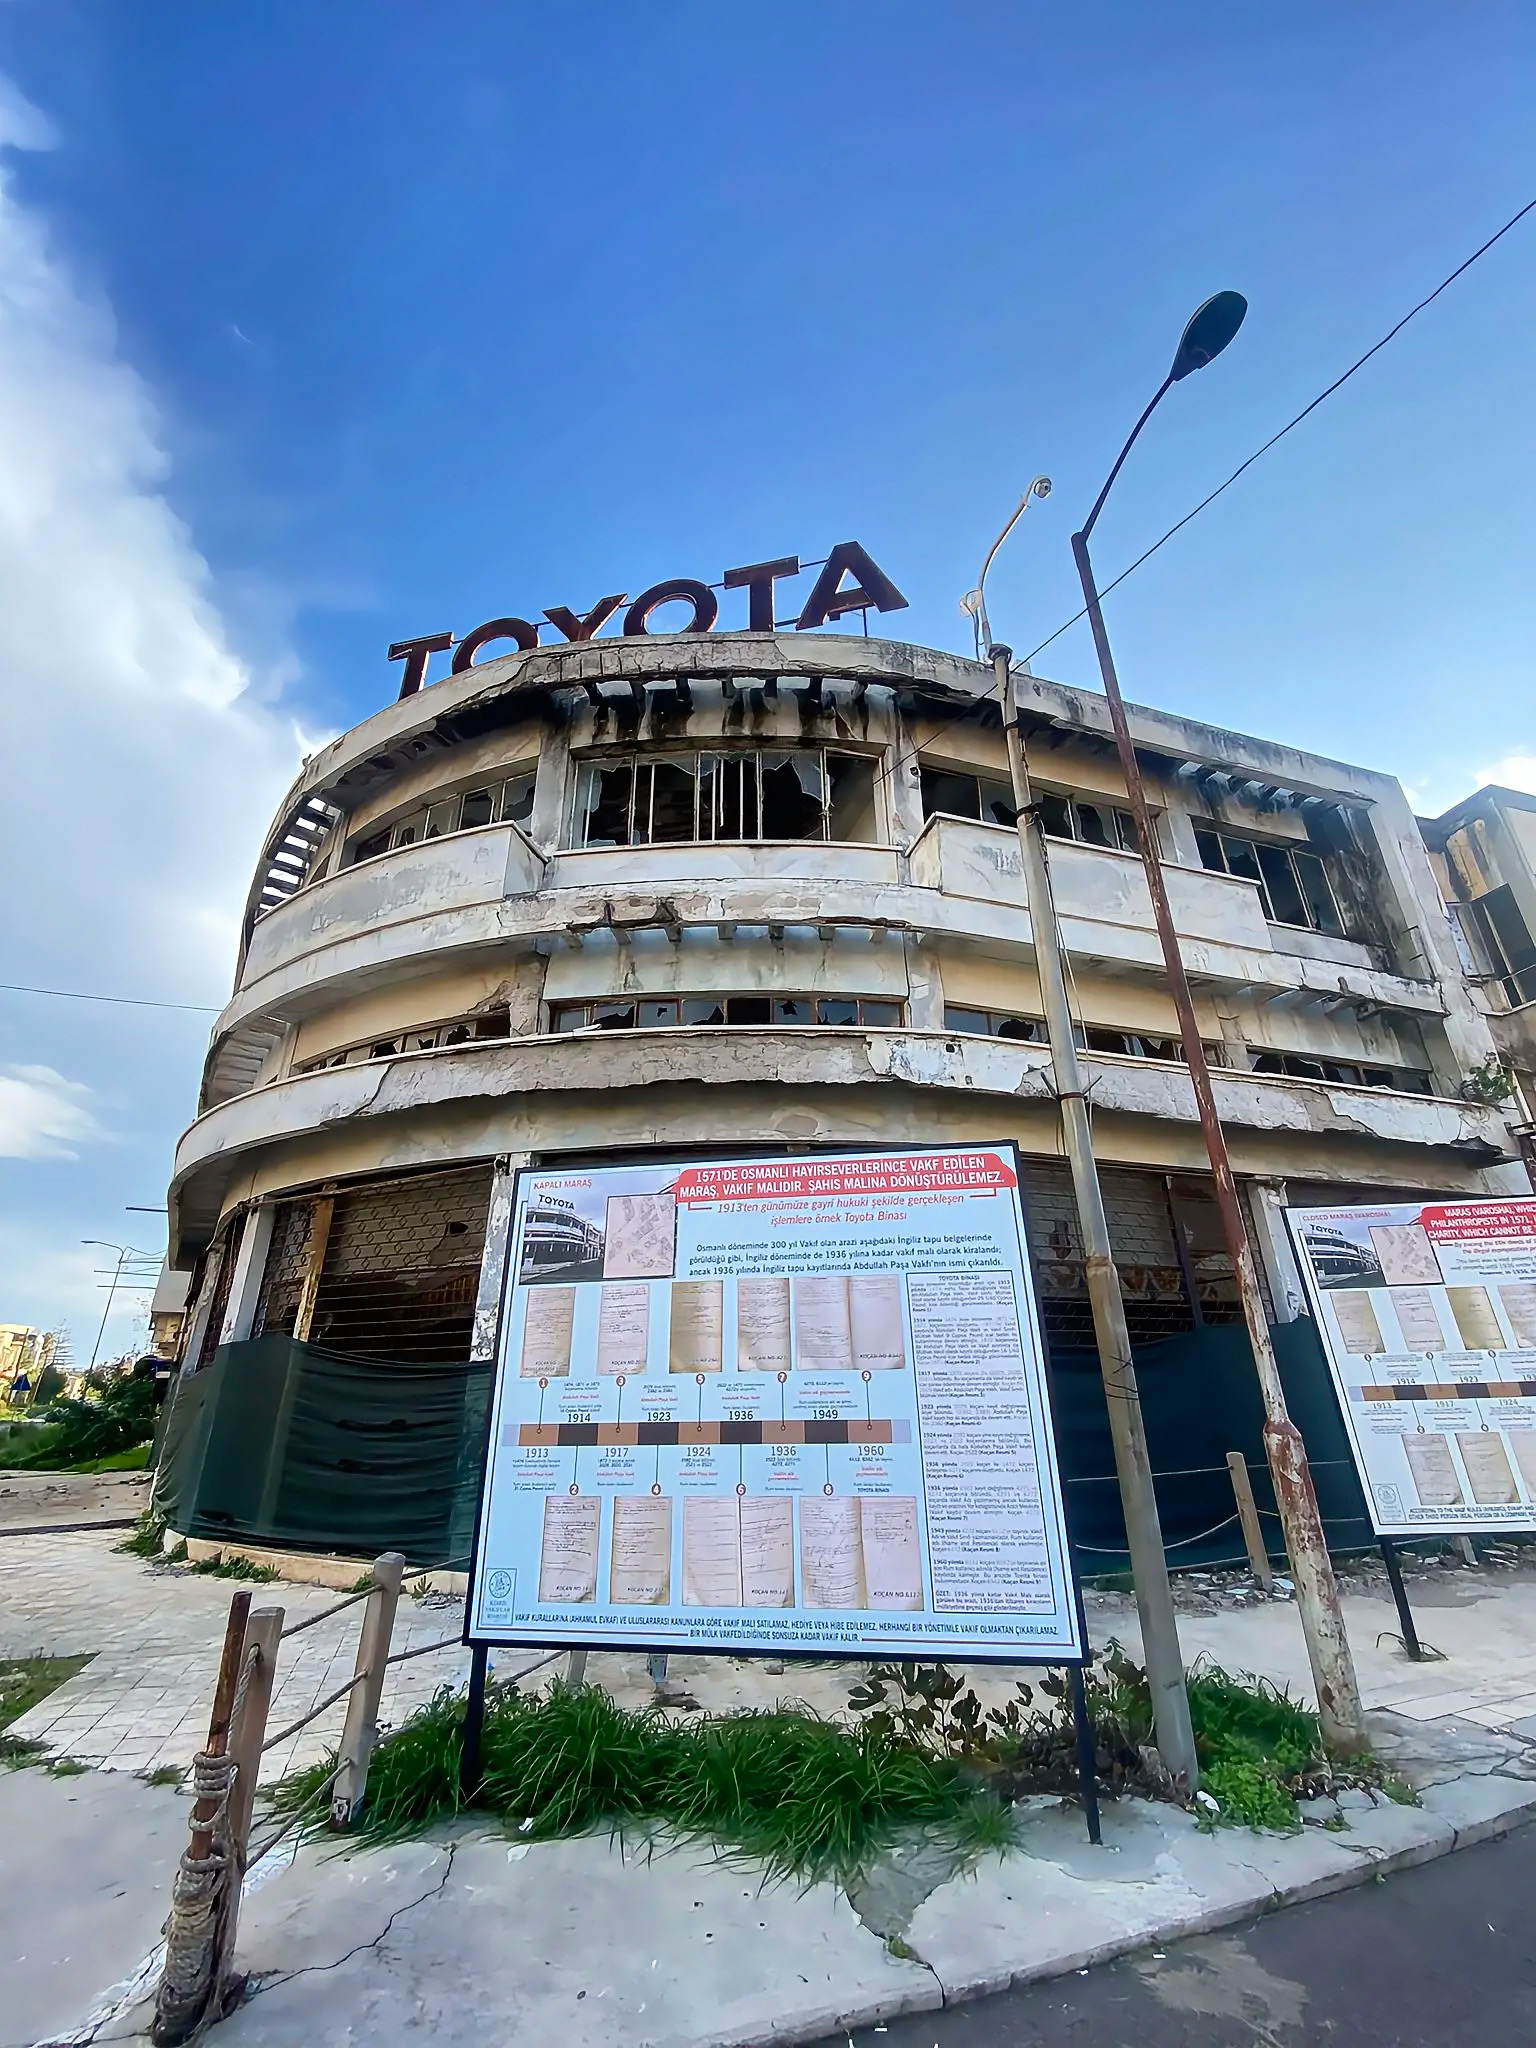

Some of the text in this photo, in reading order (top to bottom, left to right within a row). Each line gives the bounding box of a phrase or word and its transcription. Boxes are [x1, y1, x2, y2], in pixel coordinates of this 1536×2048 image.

[388, 540, 909, 701] TOYOTA
[696, 1155, 985, 1182] 1571'DE OSMANLI HAYIRSEVERLERİNCE VAKF EDİLEN
[533, 1178, 592, 1190] KAPALI MARAŞ
[680, 1171, 1004, 1199] MARAŞ, VAKIF MALIDIR. ŞAHIS MALINA DÖNÜŞTÜRÜLEMEZ.
[538, 1194, 575, 1210] TOYOTA
[717, 1202, 758, 1213] 1913'ten
[761, 1200, 809, 1213] günümüze
[871, 1195, 905, 1208] şekilde
[907, 1193, 964, 1207] gerçekleşen
[771, 1210, 906, 1227] işlemlere örnek Toyota Binası
[1430, 1217, 1499, 1228] PHILANTHROPISTS
[1500, 1217, 1509, 1225] IN
[1309, 1223, 1344, 1236] TOYOTA
[1462, 1228, 1489, 1237] WHICH
[1489, 1226, 1521, 1236] CANNOT
[1521, 1225, 1534, 1233] BE
[696, 1242, 726, 1252] Osmanlı
[727, 1241, 769, 1251] döneminde
[770, 1241, 787, 1250] 300
[788, 1240, 798, 1250] yıl
[799, 1239, 818, 1248] Vakıf
[820, 1239, 837, 1247] olan
[839, 1238, 857, 1247] arazi
[923, 1235, 942, 1246] tapu
[943, 1233, 992, 1244] belgelerinde
[727, 1254, 744, 1265] gibi,
[770, 1251, 812, 1261] döneminde
[814, 1251, 824, 1260] de
[826, 1250, 847, 1259] 1936
[872, 1248, 894, 1258] kadar
[917, 1247, 934, 1256] malı
[936, 1246, 962, 1255] olarak
[689, 1267, 712, 1276] ancak
[713, 1266, 734, 1275] 1936
[735, 1265, 761, 1276] yılında
[787, 1262, 806, 1273] tapu
[853, 1259, 889, 1270] Abdullah
[890, 1259, 910, 1270] Paşa
[1459, 1375, 1479, 1383] 1923
[1373, 1402, 1392, 1410] 1913
[1435, 1400, 1454, 1408] 1917
[1499, 1398, 1519, 1406] 1924
[567, 1413, 591, 1423] 1914
[647, 1411, 671, 1422] 1923
[728, 1410, 754, 1421] 1936
[812, 1409, 839, 1420] 1949
[525, 1448, 549, 1459] 1913
[605, 1447, 629, 1458] 1917
[687, 1446, 711, 1457] 1924
[771, 1446, 797, 1457] 1936
[857, 1445, 884, 1456] 1960
[619, 1616, 627, 1625] VE
[723, 1618, 741, 1628] VAKIF
[814, 1620, 829, 1630] VEYA
[960, 1624, 979, 1634] VAKIF
[979, 1625, 1015, 1634] OLMAKTAN
[772, 1631, 800, 1640] SONSUZA
[800, 1631, 821, 1641] KADAR
